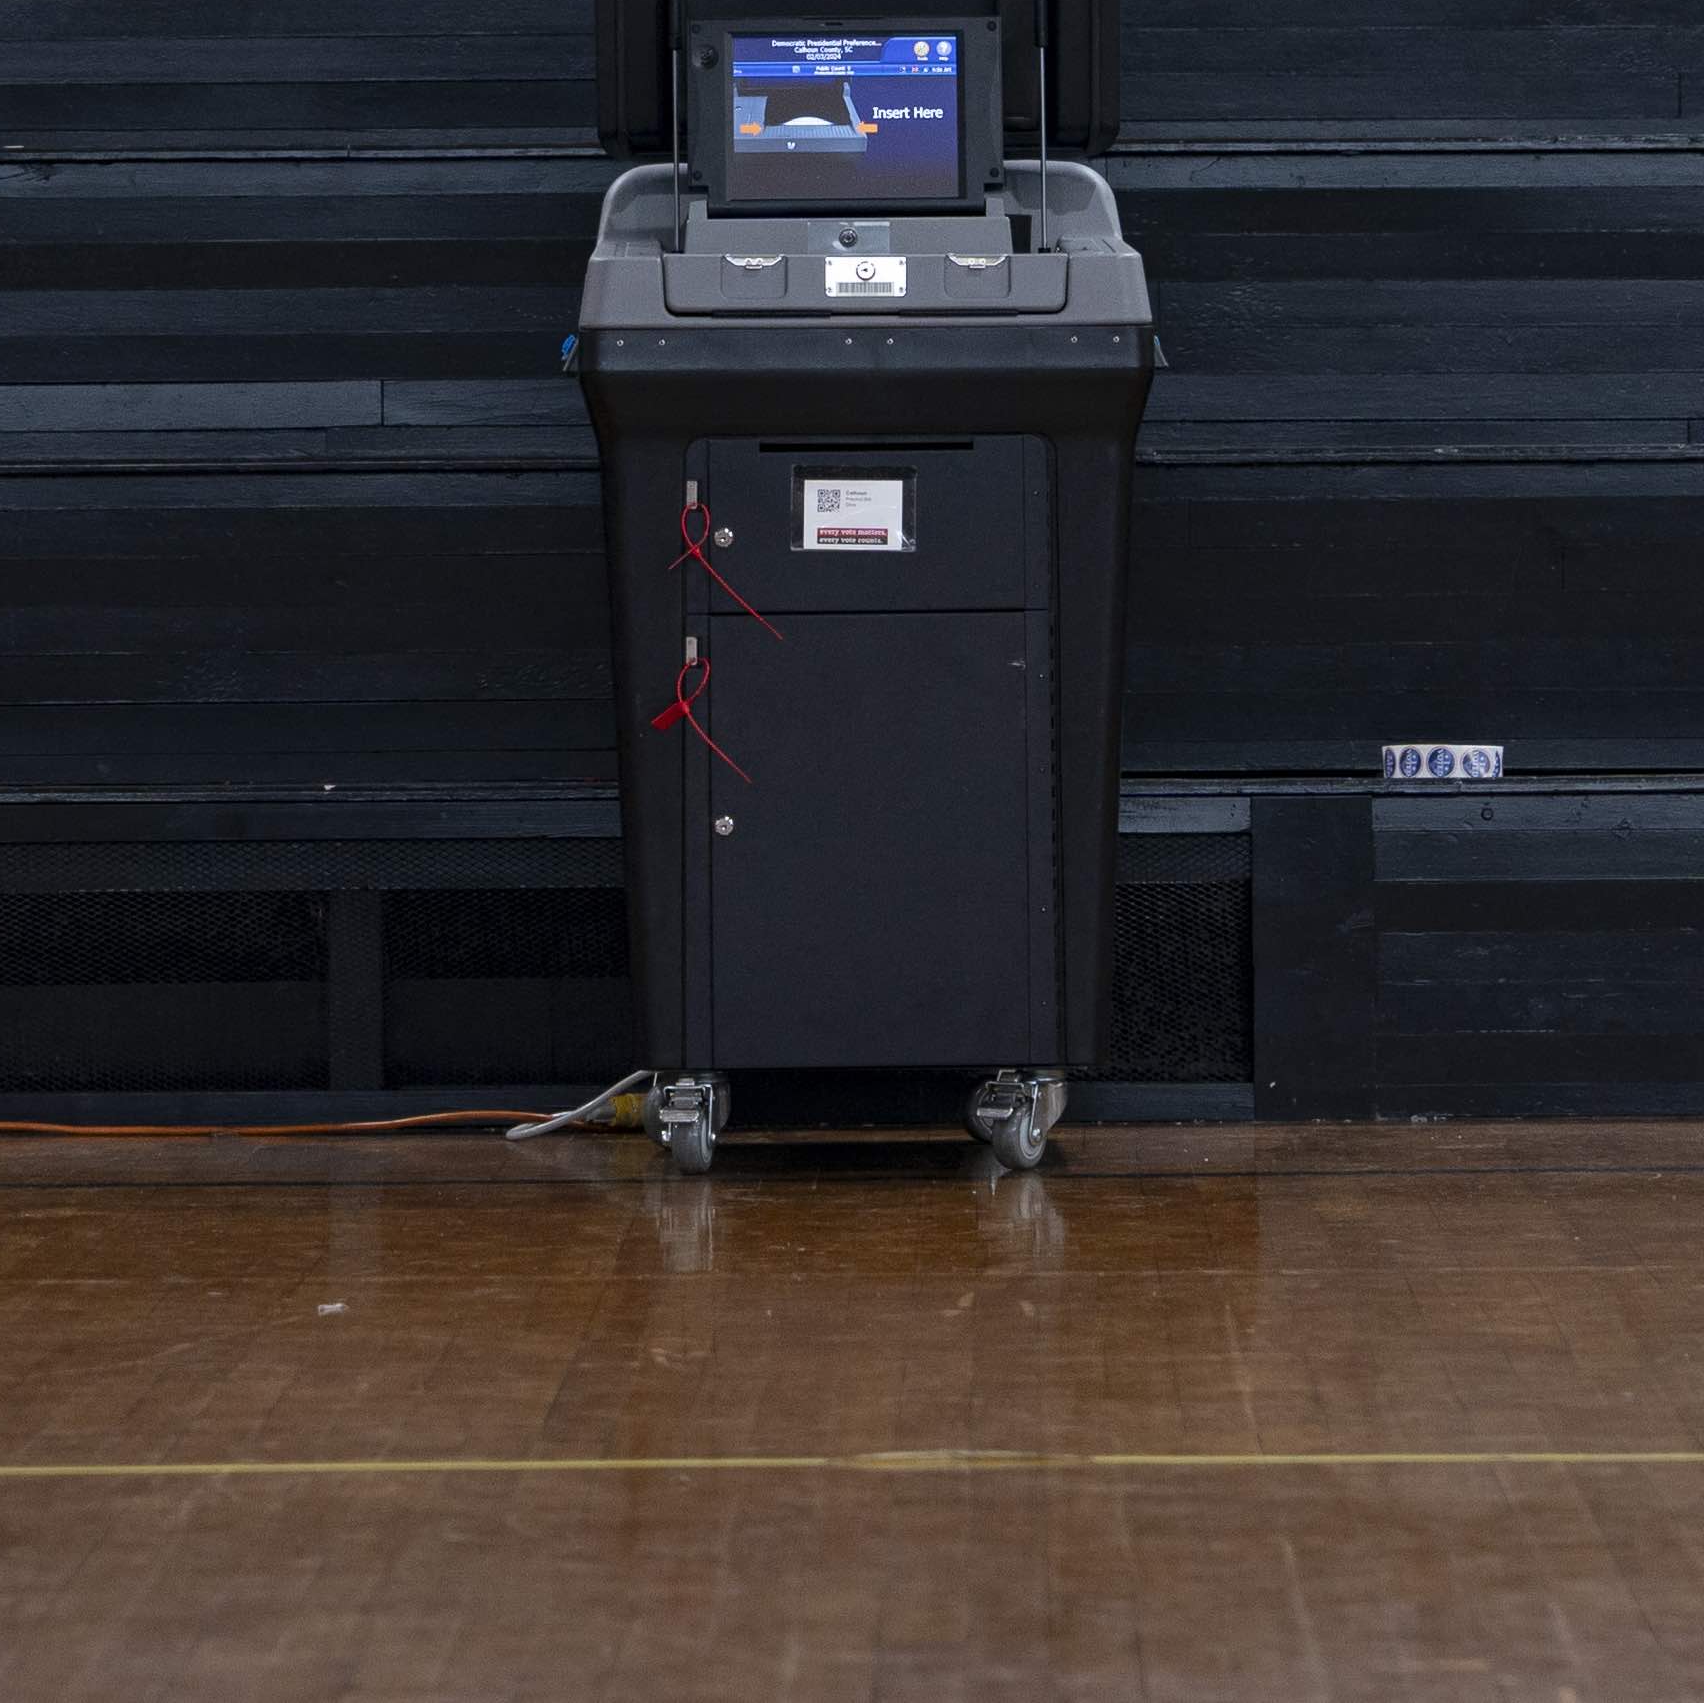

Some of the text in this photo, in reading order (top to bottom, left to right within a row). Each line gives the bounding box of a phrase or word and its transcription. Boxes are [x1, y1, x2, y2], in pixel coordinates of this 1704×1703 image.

[772, 39, 806, 47] Democratic
[807, 39, 842, 47] Presidential
[873, 106, 944, 119] Insert Here
[1436, 749, 1445, 777] VOTED
